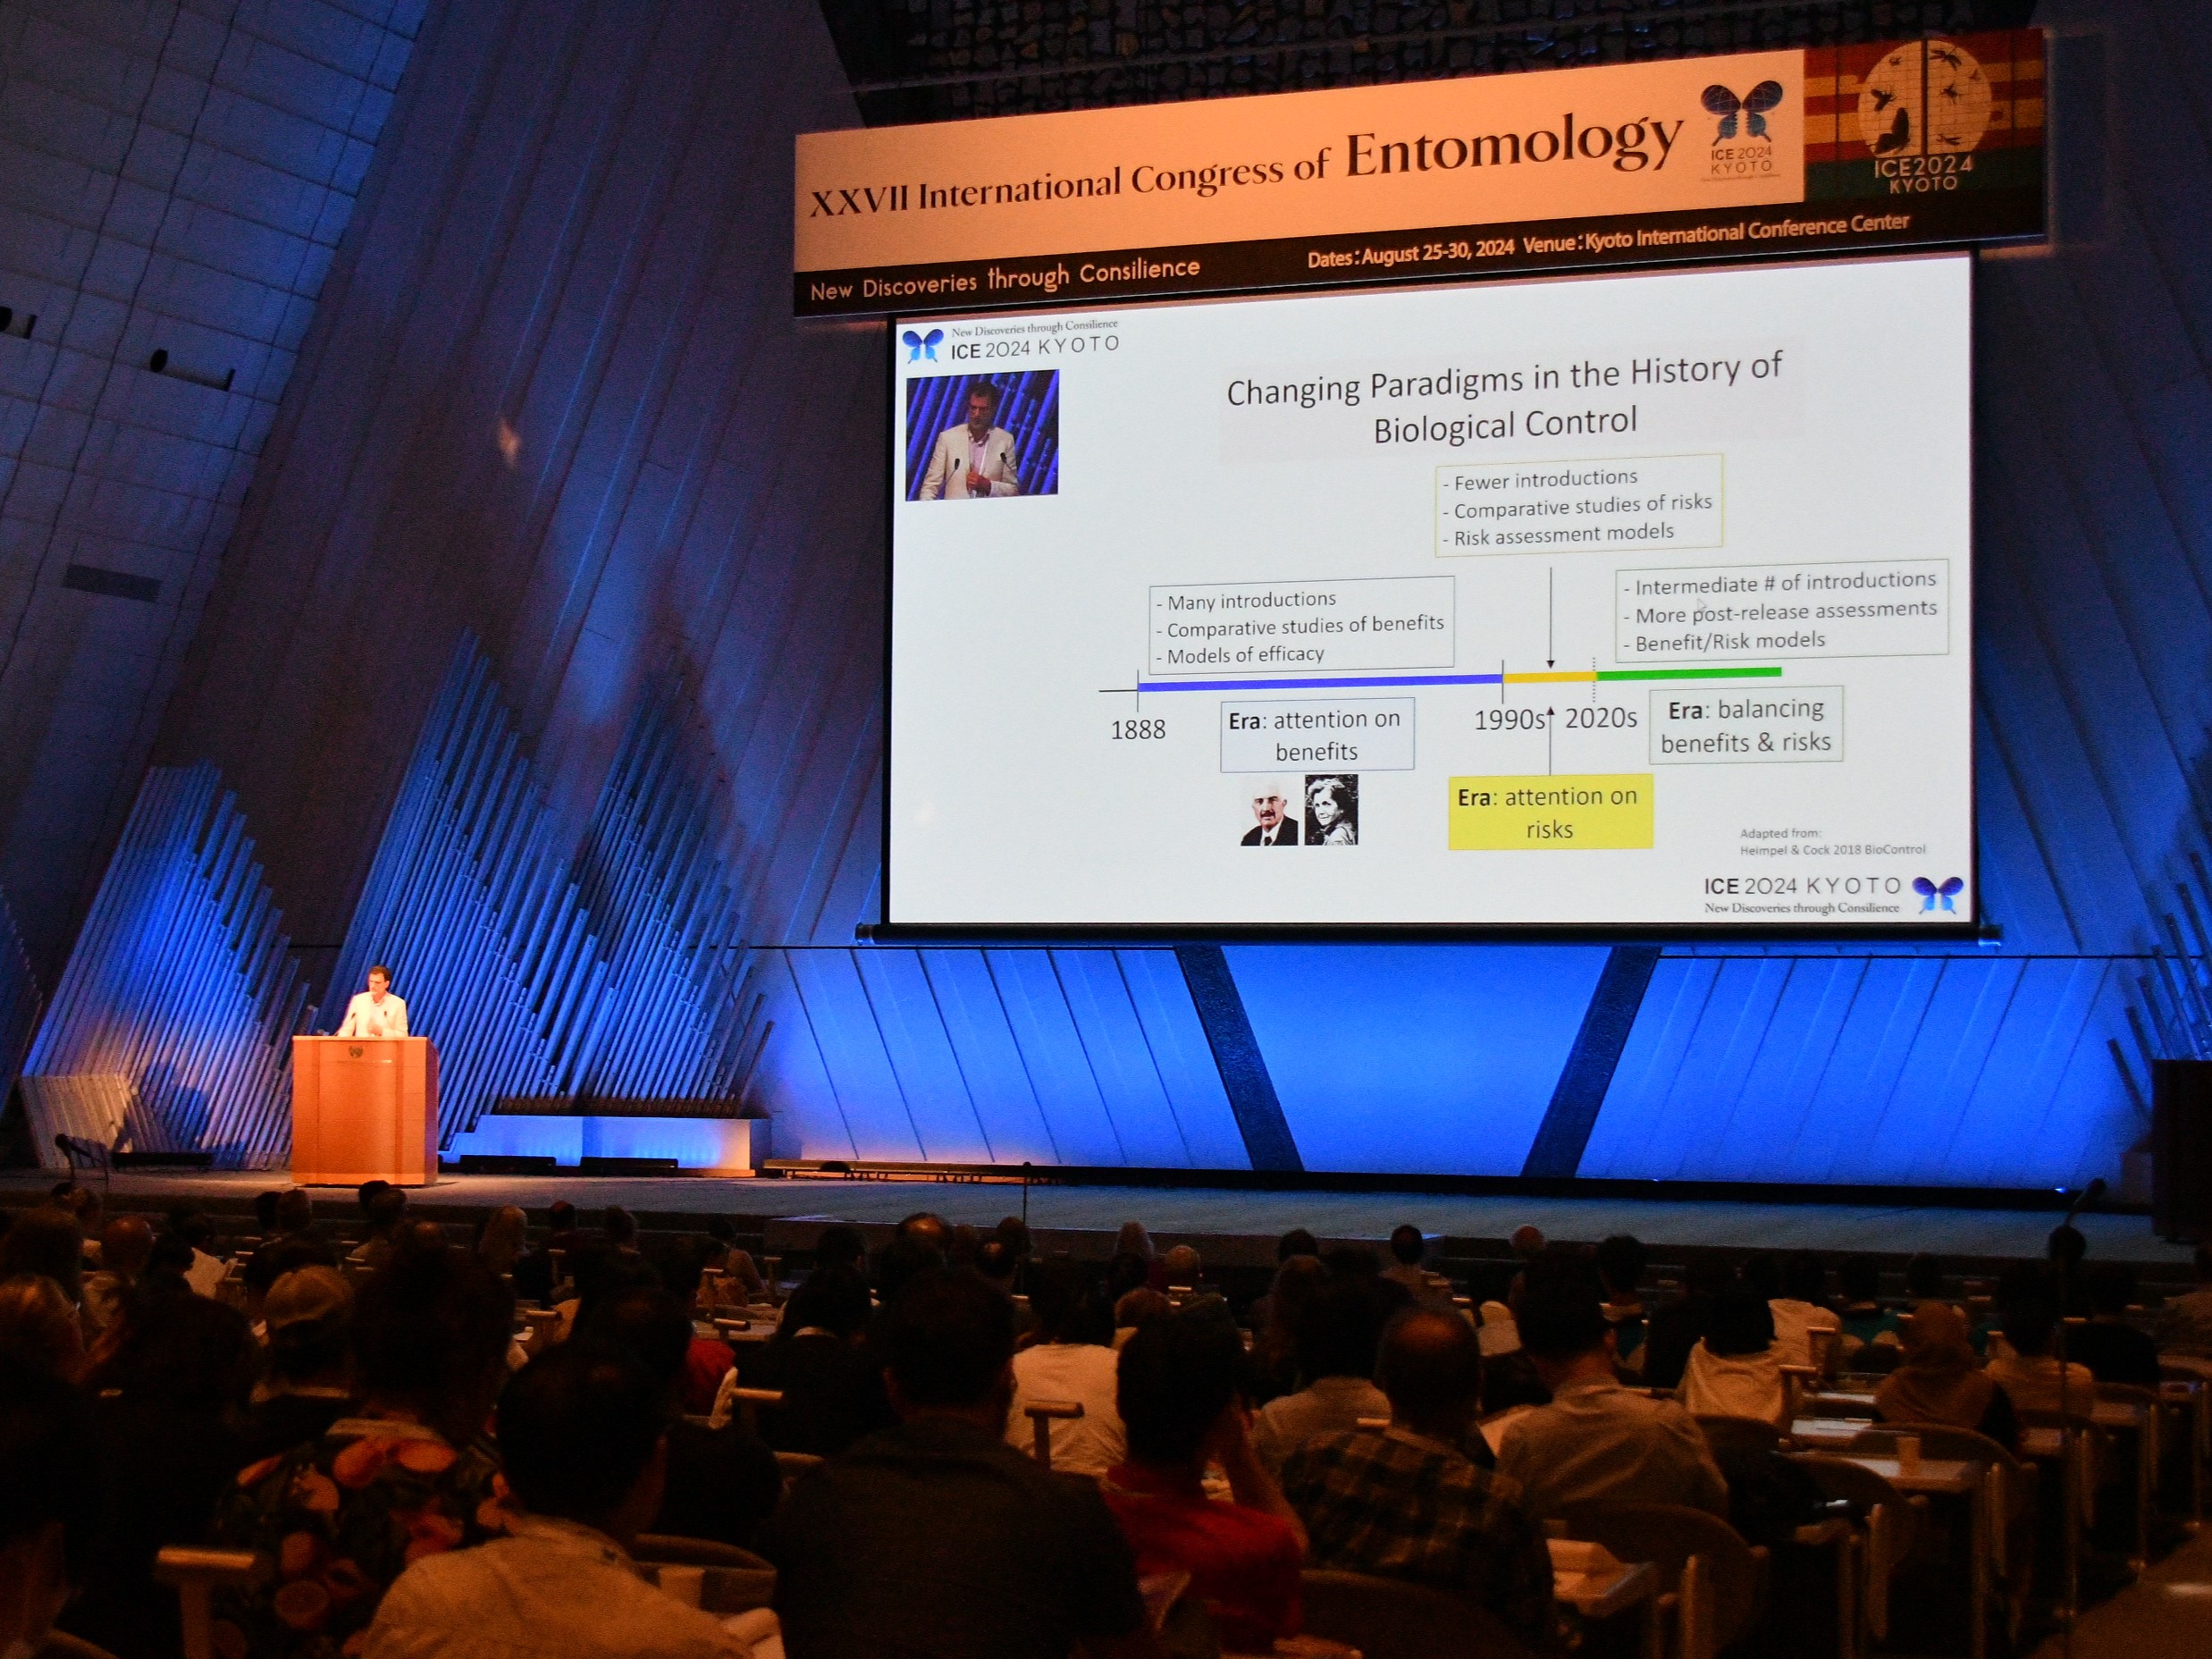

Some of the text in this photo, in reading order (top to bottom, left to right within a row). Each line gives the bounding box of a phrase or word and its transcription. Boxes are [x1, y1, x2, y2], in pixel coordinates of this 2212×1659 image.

[1712, 146, 1772, 161] ICE 2024
[810, 113, 1685, 217] XXVII International Congress of Entomology
[1712, 160, 1772, 174] KYOTO
[1890, 175, 1957, 194] KYOTO
[1423, 242, 1472, 260] 25-30,
[1476, 239, 1515, 257] 2024
[1637, 223, 1745, 246] International
[1748, 219, 1847, 239] Conference
[1851, 215, 1910, 232] Center
[812, 257, 1200, 300] New Discoveries through Consilience
[952, 320, 1118, 337] New Discoveries through Consilience
[952, 335, 1119, 359] ICE 2024 KYOTO
[1228, 349, 1783, 408] Changing Paradigms in the History of
[1375, 405, 1636, 447] Biological Control
[1456, 469, 1637, 491] Fewer introductions
[1455, 493, 1712, 520] Comparative studies of risks
[1455, 522, 1674, 546] Risk assessment models
[1636, 577, 1758, 595] Intermediate
[1781, 574, 1802, 591] of
[1807, 571, 1936, 590] introductions
[1169, 592, 1336, 612] Many introductions
[1636, 601, 1938, 626] More post-release assessments
[1168, 614, 1444, 640] Comparative studies of benefits
[1636, 630, 1825, 653] Benefit/Risk models
[1168, 645, 1325, 664] Models of efficacy
[1230, 710, 1400, 729] Era: attention on
[1476, 709, 1545, 730] 1990s
[1566, 707, 1637, 728] 2020s
[1670, 699, 1824, 721] Era: balancing
[1112, 720, 1165, 739] 1888
[1276, 741, 1358, 762] benefits
[1662, 732, 1749, 754] benefits
[1783, 731, 1831, 751] risks
[1459, 787, 1636, 806] Era: attention on
[1527, 819, 1573, 838] risks
[1741, 829, 1821, 840] Adapted from:
[1741, 846, 1787, 857] Heimpel
[1804, 845, 1829, 855] Cock
[1833, 845, 1862, 855] 2018
[1865, 844, 1926, 855] BioControl
[1705, 877, 1901, 895] ICE 2024 KYOTO
[1705, 903, 1900, 916] New Discoveries through Consilience
